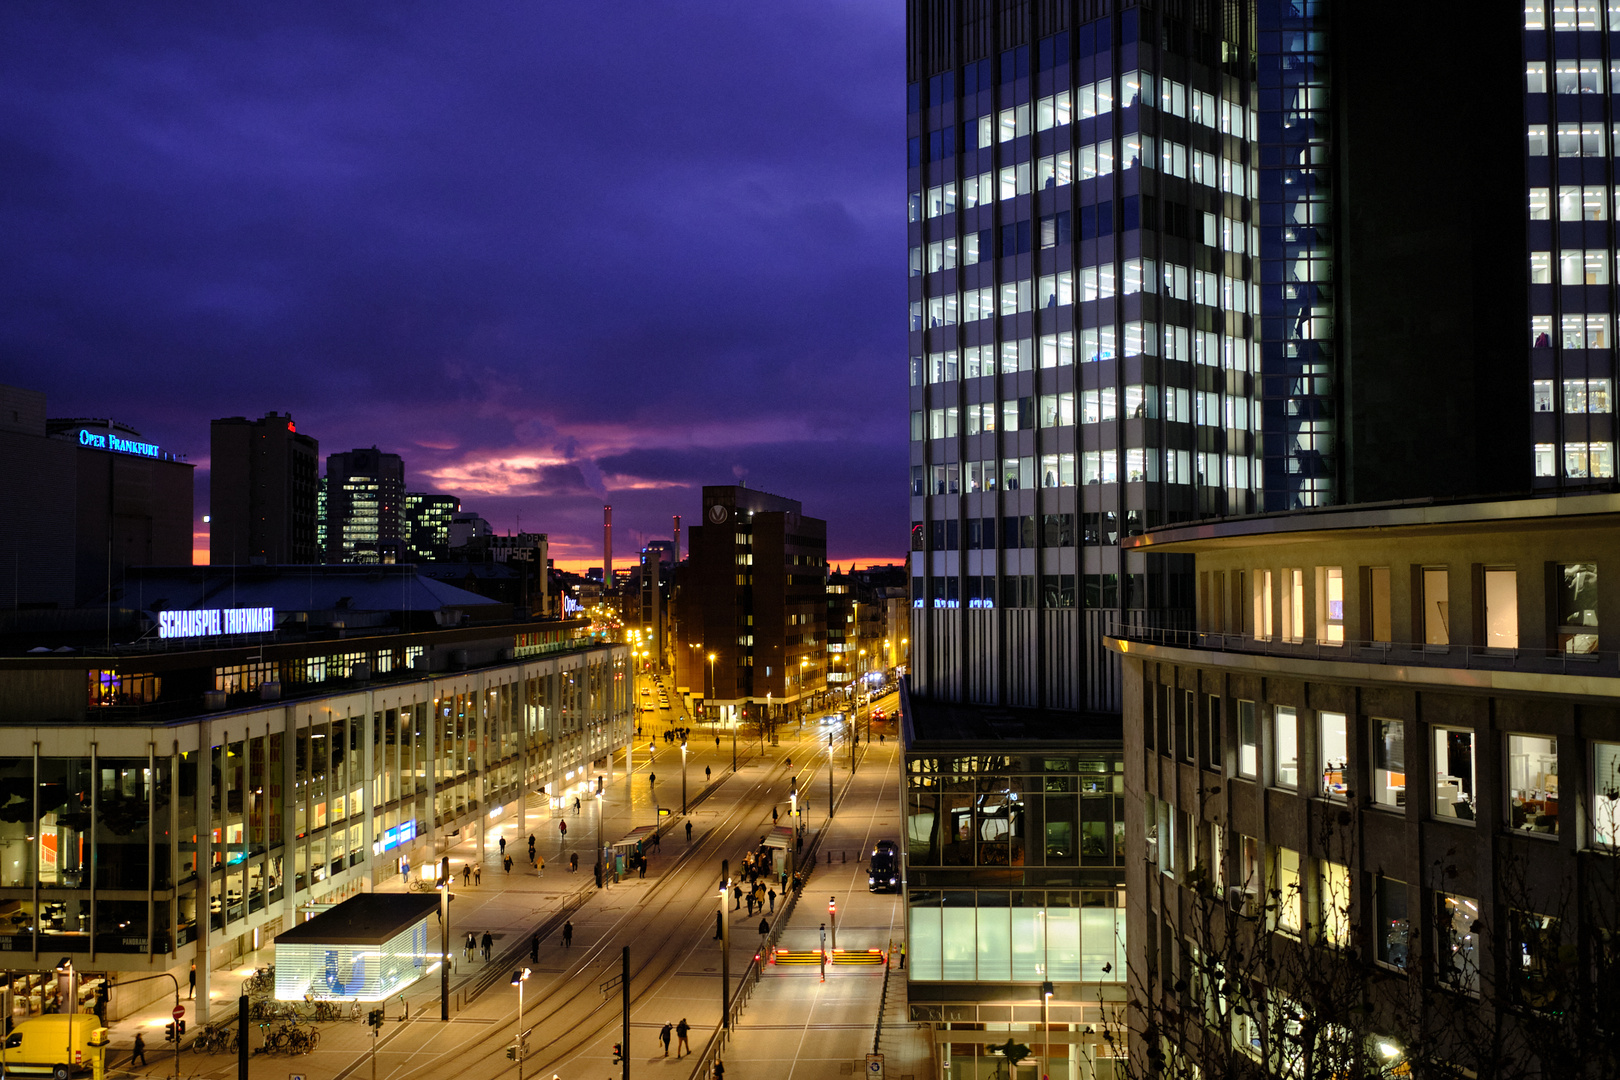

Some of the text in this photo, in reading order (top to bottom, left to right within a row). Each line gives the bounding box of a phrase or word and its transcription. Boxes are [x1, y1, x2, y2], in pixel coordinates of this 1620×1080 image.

[108, 434, 160, 458] FRANKFURT
[159, 609, 222, 638] SCHAUSPIEL
[325, 950, 365, 996] U
